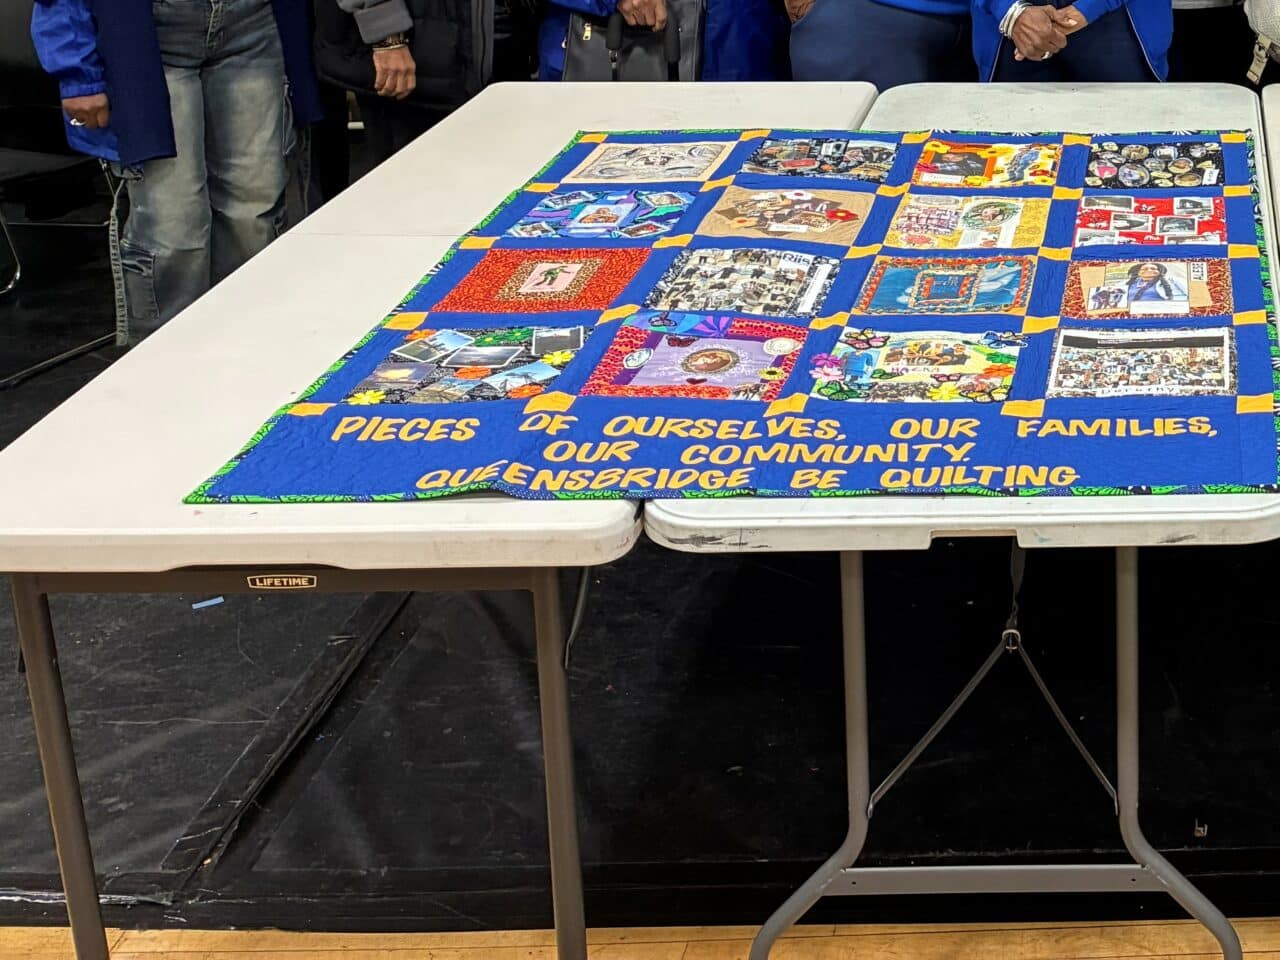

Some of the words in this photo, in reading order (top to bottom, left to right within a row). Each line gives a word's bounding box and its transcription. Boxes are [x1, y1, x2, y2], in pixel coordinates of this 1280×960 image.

[782, 252, 811, 266] Riis
[331, 416, 481, 442] PIECES
[603, 416, 846, 443] OURSELVES,
[890, 418, 981, 440] OUR
[1016, 416, 1218, 439] FAMILIES,
[542, 440, 639, 463] OUR
[416, 460, 749, 492] QUEENSBRIDGE
[790, 469, 848, 489] BE
[879, 465, 1081, 487] QUILTING
[255, 577, 309, 586] LIFETIME
